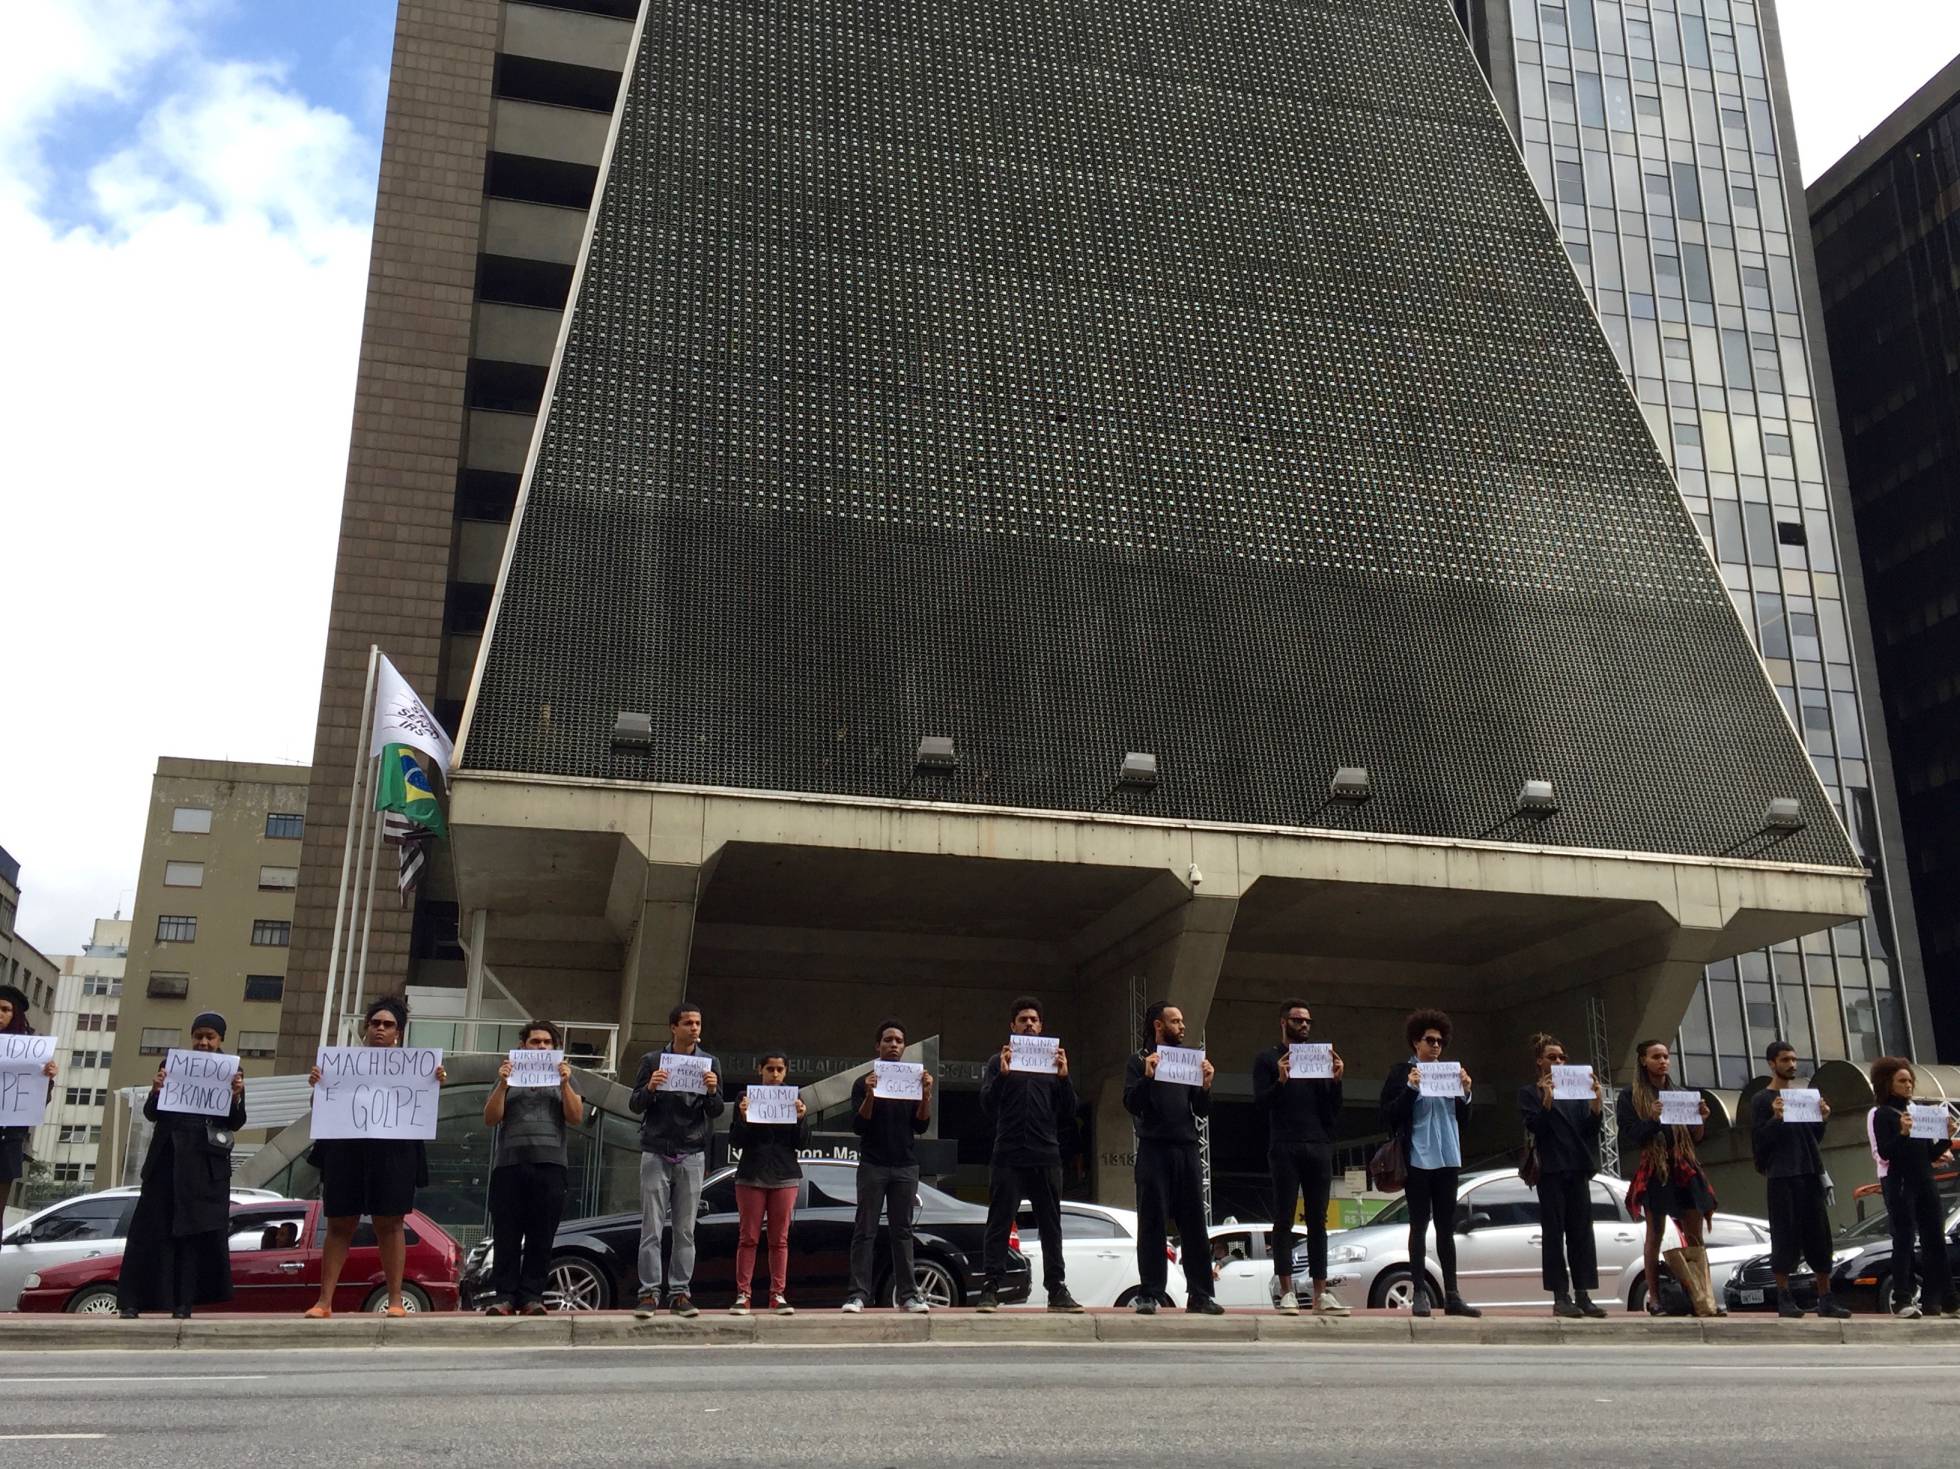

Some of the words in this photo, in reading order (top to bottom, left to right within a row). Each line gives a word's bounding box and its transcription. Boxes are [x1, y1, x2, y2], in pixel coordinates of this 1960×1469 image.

[0, 1036, 47, 1059] ÍDIO
[514, 1051, 552, 1062] DIREITA
[170, 1054, 232, 1082] MEDO
[320, 1049, 436, 1078] MACHISMO
[164, 1081, 231, 1111] BRANCO
[326, 1081, 341, 1102] É
[749, 1087, 795, 1101] RACISMO
[352, 1083, 429, 1132] GOLPE
[833, 1146, 861, 1160] Ma
